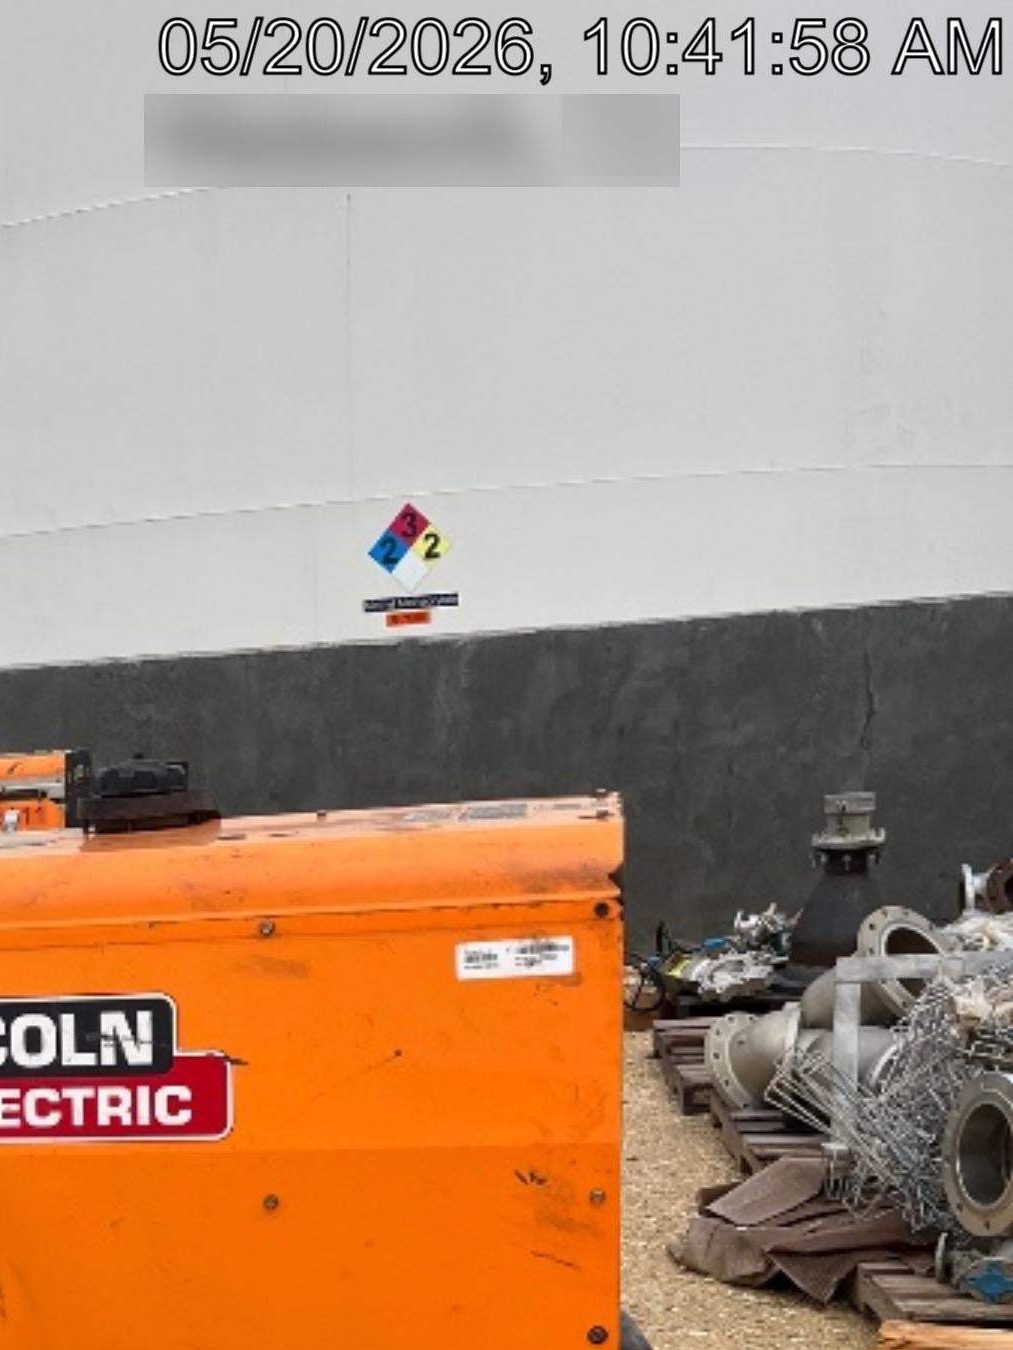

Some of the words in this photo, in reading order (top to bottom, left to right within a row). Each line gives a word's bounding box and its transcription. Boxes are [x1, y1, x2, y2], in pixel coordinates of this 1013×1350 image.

[401, 512, 418, 538] 3
[380, 537, 398, 565] 2
[423, 532, 442, 561] 2
